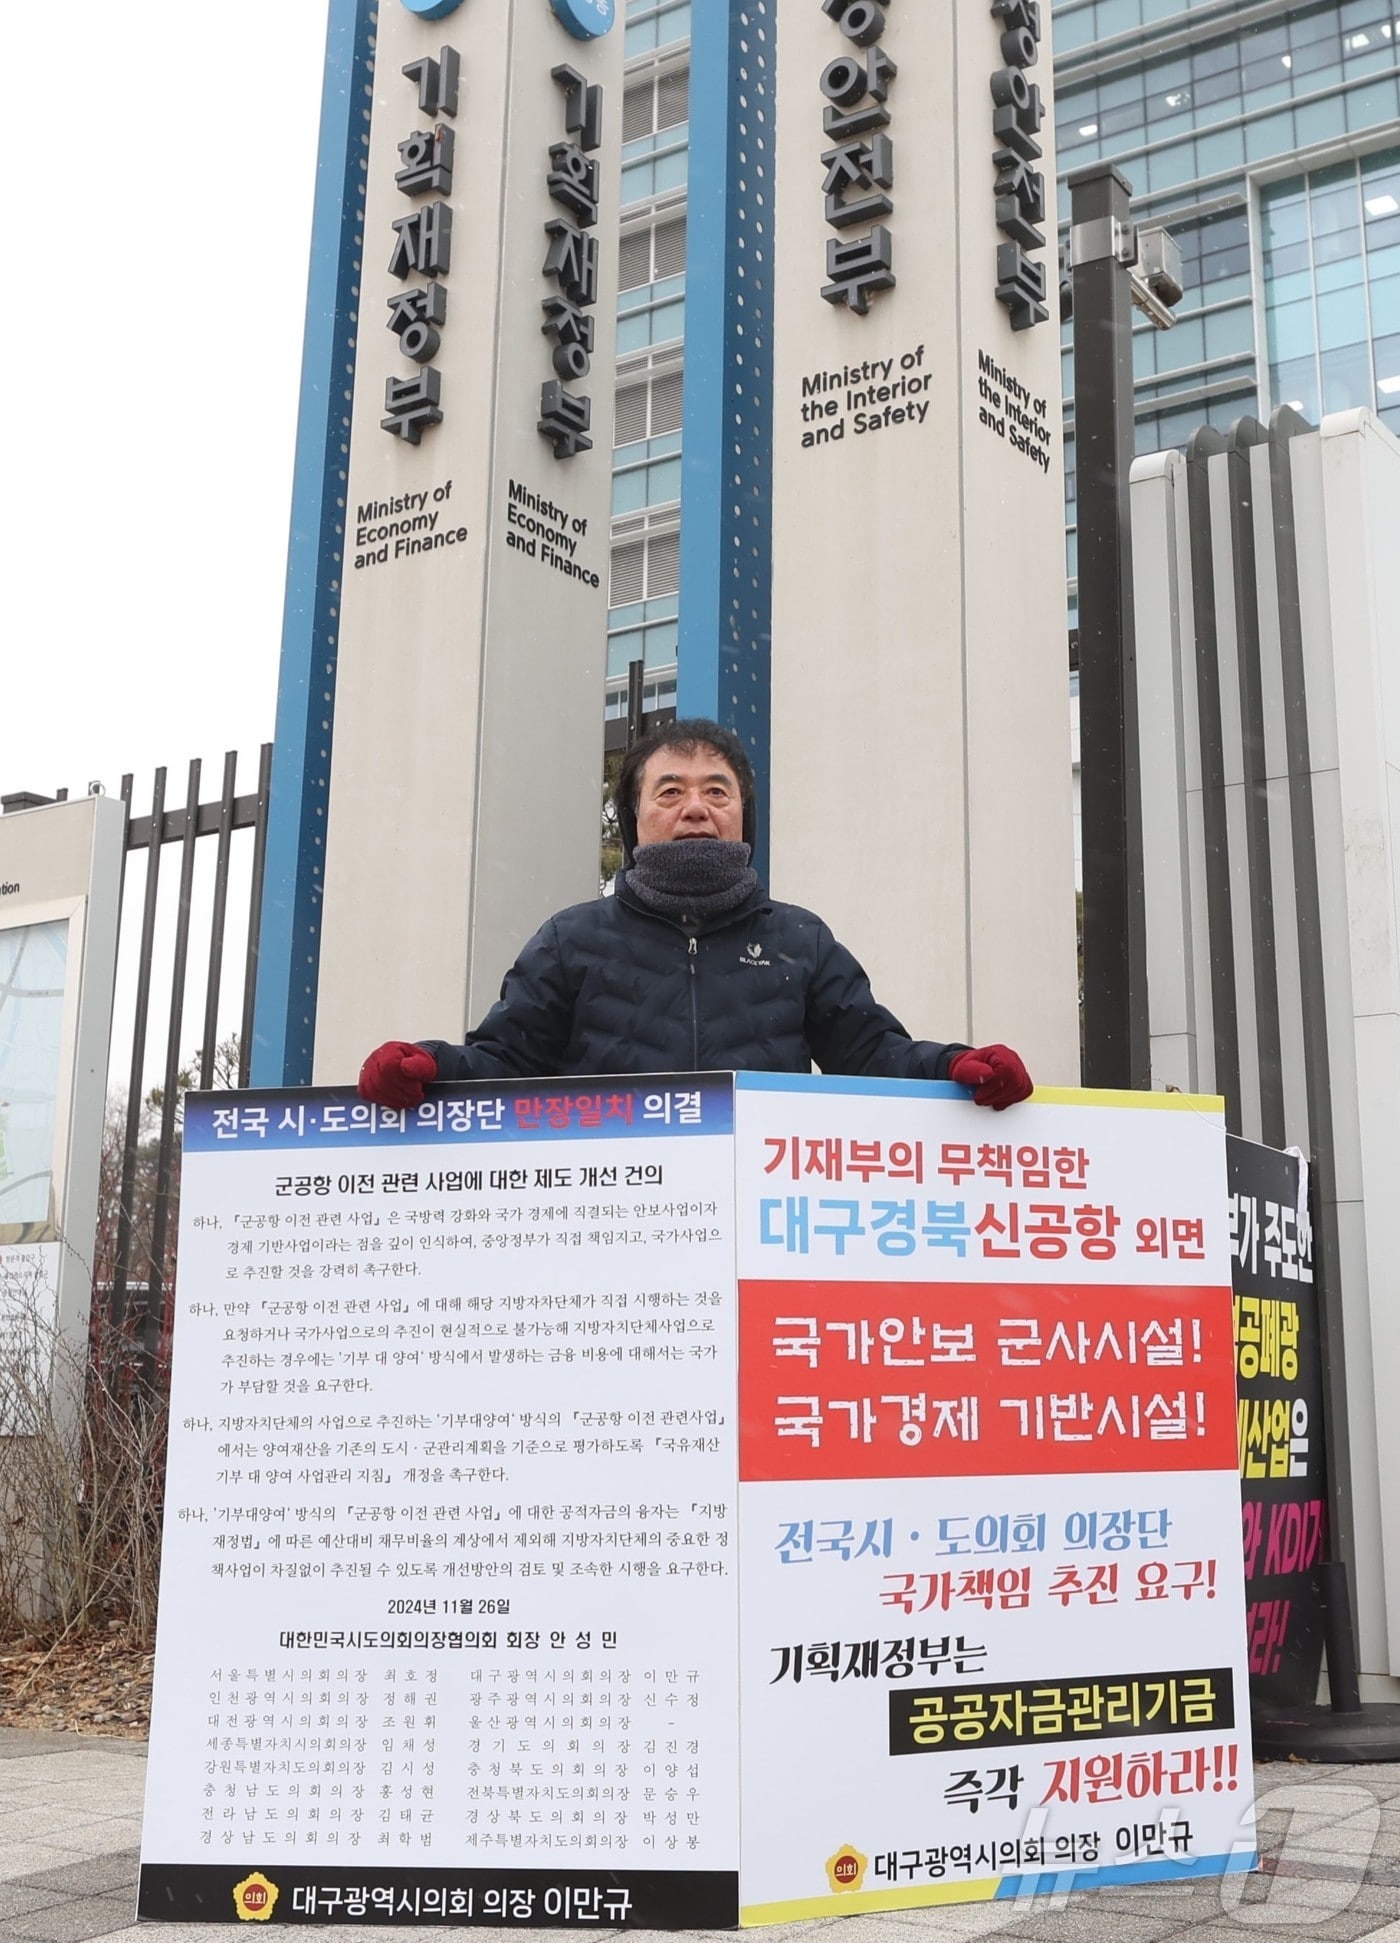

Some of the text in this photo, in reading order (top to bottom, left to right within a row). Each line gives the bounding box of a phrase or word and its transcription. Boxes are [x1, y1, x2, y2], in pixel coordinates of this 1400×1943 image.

[380, 45, 460, 446] 기획재정부
[537, 63, 604, 461] 기획재정부
[802, 344, 925, 398] Ministry of
[978, 349, 1047, 419] Ministry of
[801, 373, 932, 422] the Interior
[978, 376, 1051, 446] the Interior
[801, 400, 930, 448] and Safety
[979, 406, 1050, 474] and Safety
[357, 480, 452, 524] Ministry of
[509, 479, 588, 537] Ministry of
[354, 527, 468, 569] and Finance
[356, 511, 439, 546] Economy
[508, 502, 577, 558] Economy
[506, 531, 600, 588] and Finance
[0, 882, 20, 896] tion
[212, 1106, 269, 1139] 전국
[416, 1098, 506, 1133] 의장단
[514, 1093, 634, 1130] 만장일치
[643, 1091, 702, 1124] 의결
[275, 1164, 663, 1197] 군공항 이전 관련 사업에 대한 제도 개선 건의
[765, 1136, 1089, 1190] 기재부의 무책임한
[228, 1227, 722, 1255] 경제 기반사업이라는 점을 깊이 인식하여, 중앙정부가 직접 책임지고, 국가사업으
[760, 1195, 1206, 1261] 대구경북신공항 외면
[225, 1261, 422, 1280] 로 추진할 것을 강력히 촉구한다.
[222, 1317, 715, 1342] 요청하거나 국가사업으로의 추진이 현실적으로 불가능해 지방자치단체사업으로
[772, 1315, 1202, 1368] 국가안보 군사시설!
[1234, 1295, 1300, 1382] 공폐광
[221, 1377, 373, 1394] 가 부담할 것을 요구한다.
[182, 1415, 213, 1431] 하나,
[219, 1414, 313, 1432] 지방자치단체의
[317, 1414, 373, 1431] 사업으로
[376, 1413, 432, 1429] 추진하는
[519, 1410, 561, 1428] 방식의
[627, 1409, 655, 1425] 이전
[774, 1390, 1206, 1448] 국가경제 기반시설!
[217, 1441, 259, 1457] 에서는
[262, 1440, 332, 1458] 양여재산을
[336, 1440, 376, 1457] 기존의
[381, 1440, 408, 1456] 도시
[423, 1439, 507, 1456] 군관리계획을
[512, 1438, 568, 1454] 기준으로
[572, 1437, 644, 1454] 평가하도록
[216, 1468, 244, 1484] 기부
[248, 1468, 261, 1483] 대
[265, 1468, 292, 1485] 양여
[298, 1467, 352, 1484] 사업관리
[403, 1466, 445, 1482] 개정을
[448, 1466, 509, 1483] 촉구한다.
[774, 1516, 893, 1564] 전국시
[934, 1511, 1047, 1556] 도의회
[1063, 1507, 1173, 1551] 의장단
[211, 1560, 728, 1578] 책사업이 차질없이 추진될 수 있도록 개선방안의 검토 및 조속한 시행을 요구한다.
[879, 1558, 1217, 1615] 국가책임 추진 요구!
[387, 1597, 510, 1615] 2024년 11월 26일
[279, 1631, 497, 1650] 대한민국시도의회의장협의회
[506, 1631, 541, 1650] 회장
[769, 1634, 988, 1685] 기획재정부는
[909, 1678, 1215, 1744] 공공자금관리기금
[943, 1743, 1238, 1814] 즉각 지원하라!!
[836, 1862, 858, 1878] 의회
[874, 1819, 1194, 1882] 대구광역시의회 의장 이만규
[244, 1892, 267, 1905] 의회
[292, 1885, 633, 1920] 대구광역시의회 의장 이만규
